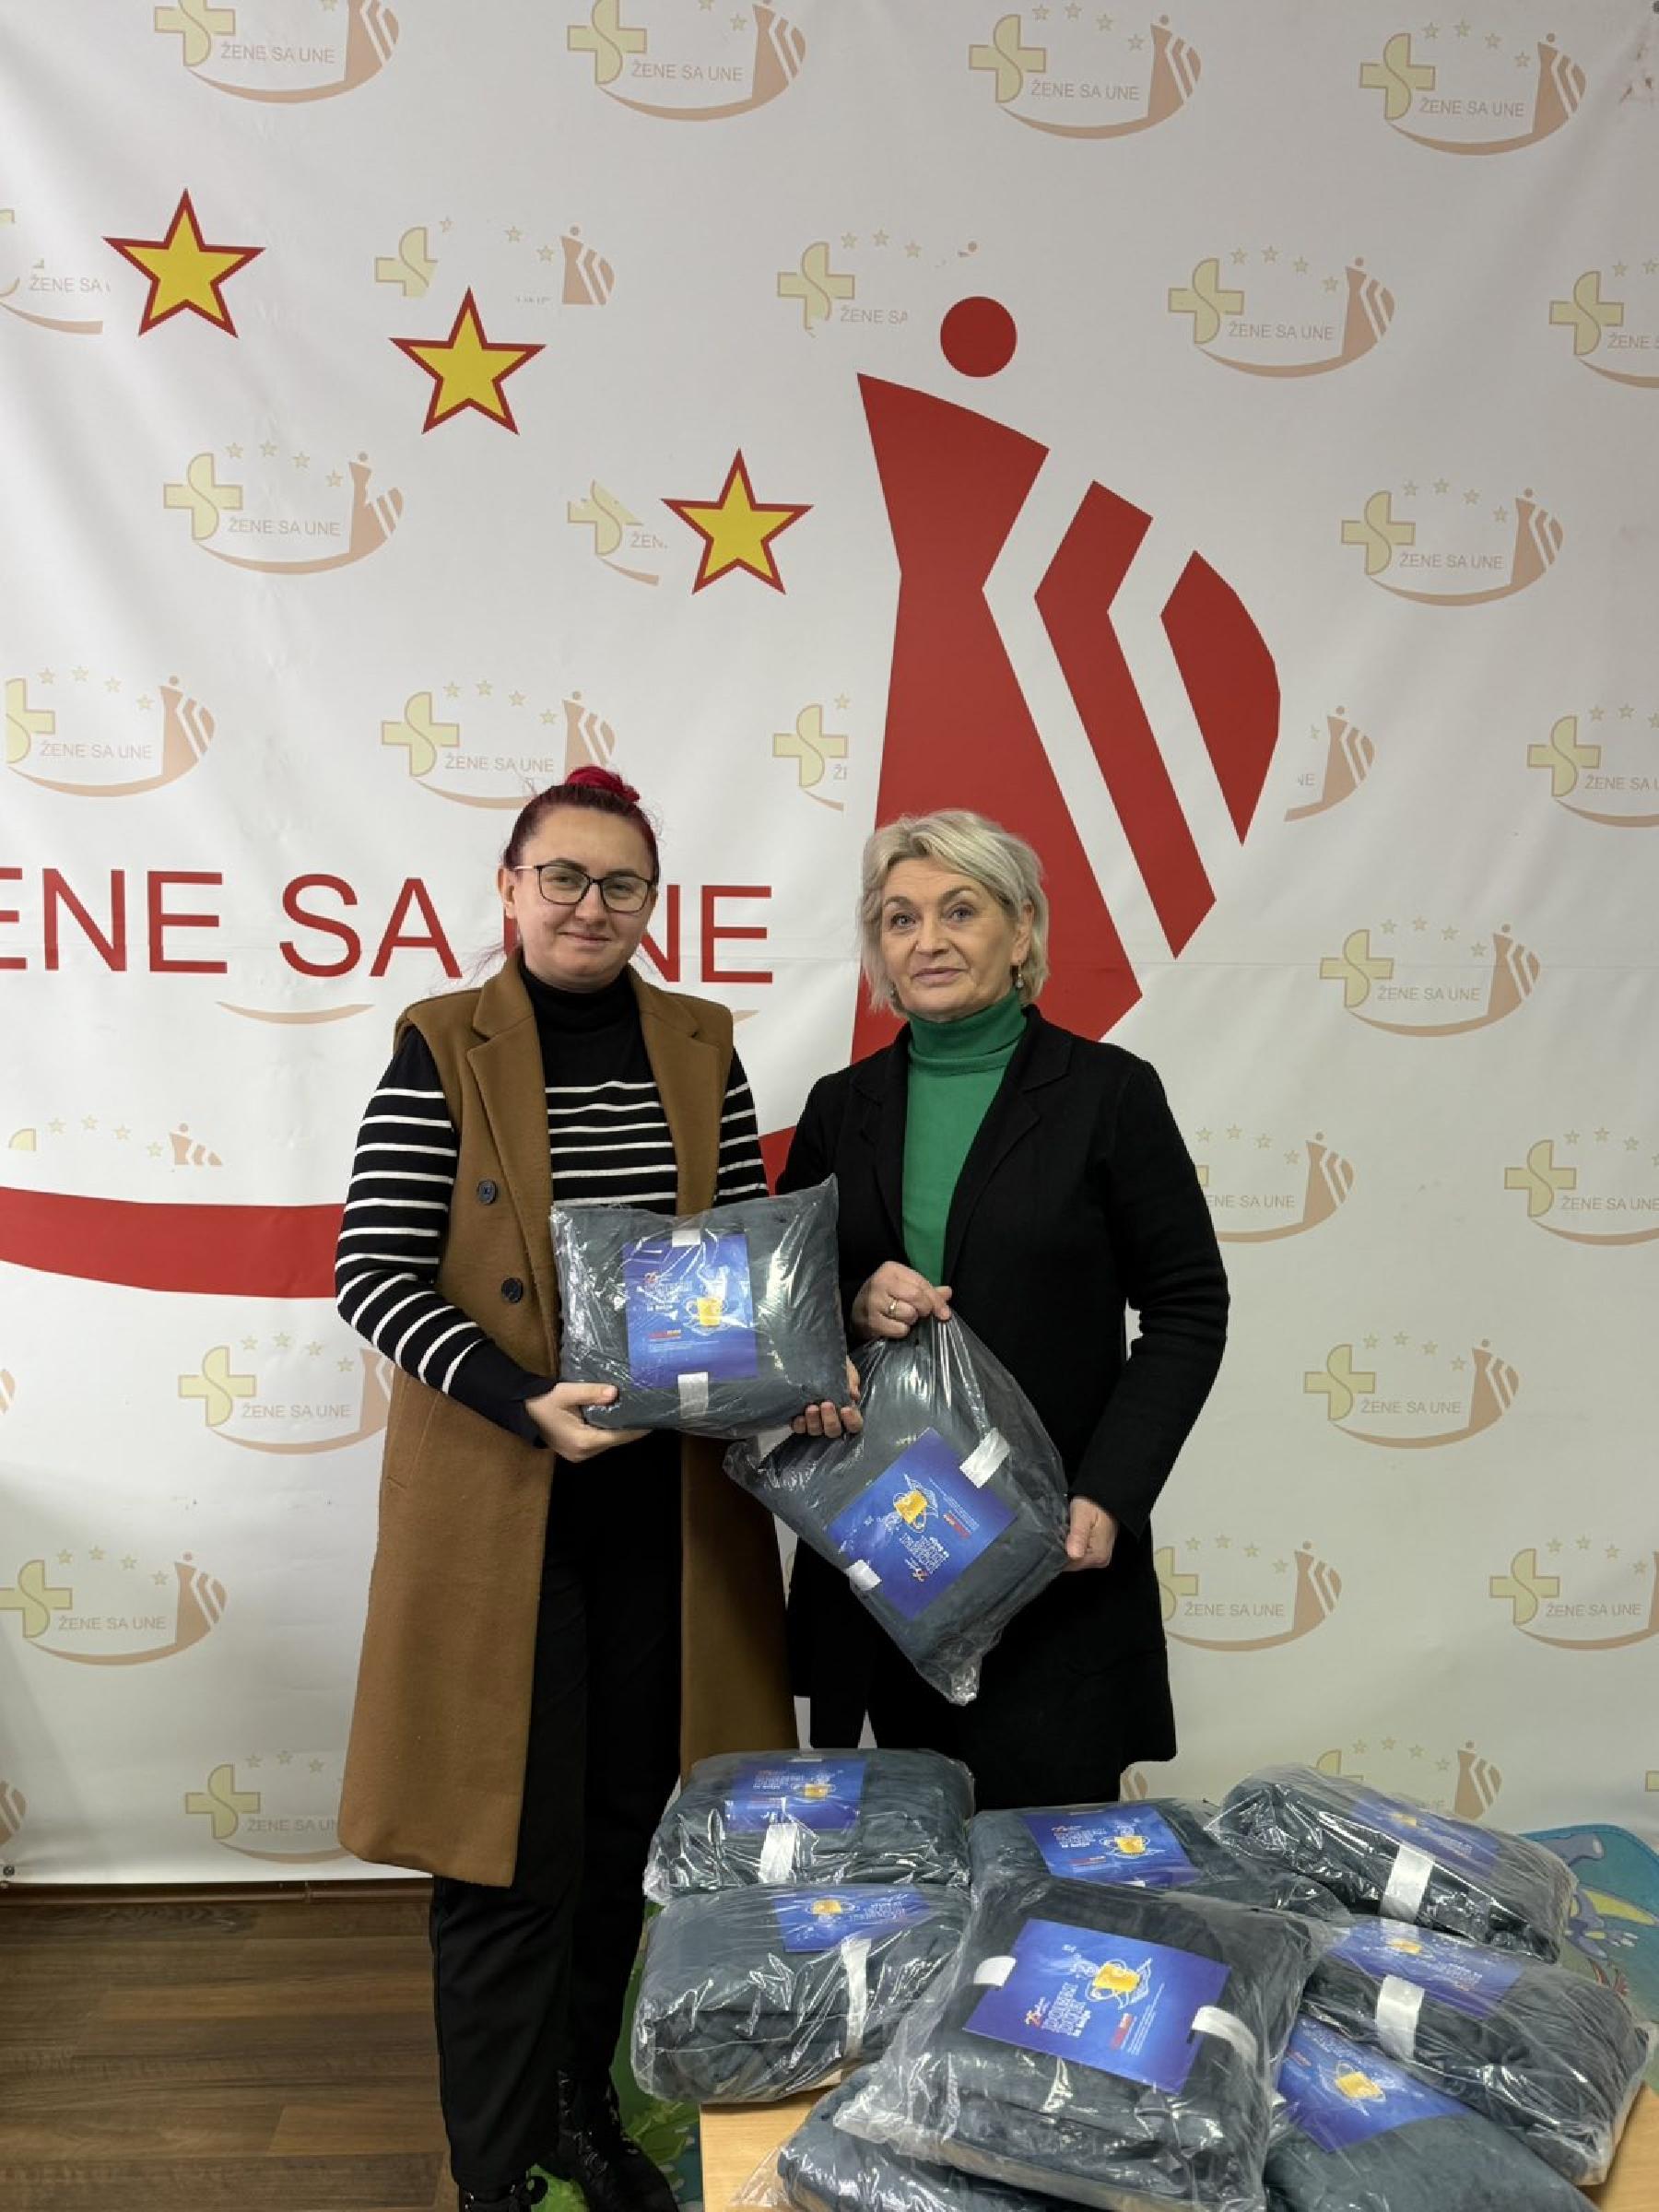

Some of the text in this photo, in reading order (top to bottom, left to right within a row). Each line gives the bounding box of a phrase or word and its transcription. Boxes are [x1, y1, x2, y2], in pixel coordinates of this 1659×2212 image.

[220, 41, 335, 65] ŽENE SA UNE
[631, 59, 744, 81] ŽENE SA UNE
[1031, 79, 1140, 100] ŽENE SA UNE
[1418, 97, 1524, 117] ŽENE SA UNE
[29, 274, 75, 293] ŽENE
[80, 276, 102, 294] SA
[840, 305, 885, 323] ŽENE
[1229, 321, 1335, 340] ŽENE SA UNE
[1606, 332, 1651, 349] ŽENE
[228, 516, 341, 536] ŽENE SA UNE
[630, 531, 668, 549] ŽEN
[1399, 550, 1504, 570] ŽENE SA UNE
[40, 740, 152, 759] ŽENE SA UNE
[444, 752, 554, 772] ŽENE SA UNE
[1585, 774, 1625, 790] ŽENE
[1630, 776, 1650, 791] SA
[278, 874, 462, 981] SA
[1377, 984, 1481, 1001] ŽENE SA UNE
[1240, 1194, 1261, 1208] SA
[1264, 1194, 1295, 1208] UNE
[1560, 1194, 1602, 1209] ŽENE
[1606, 1197, 1626, 1210] SA
[241, 1401, 352, 1418] ŽENE SA UNE
[1359, 1398, 1461, 1415] ŽENE SA UNE
[1183, 1601, 1284, 1617] ŽENE SA UNE
[1546, 1602, 1642, 1617] ŽENE SA UNE
[58, 1615, 167, 1630] ŽENE SA UNE
[247, 1818, 288, 1832] ŽENE
[294, 1818, 315, 1832] SA
